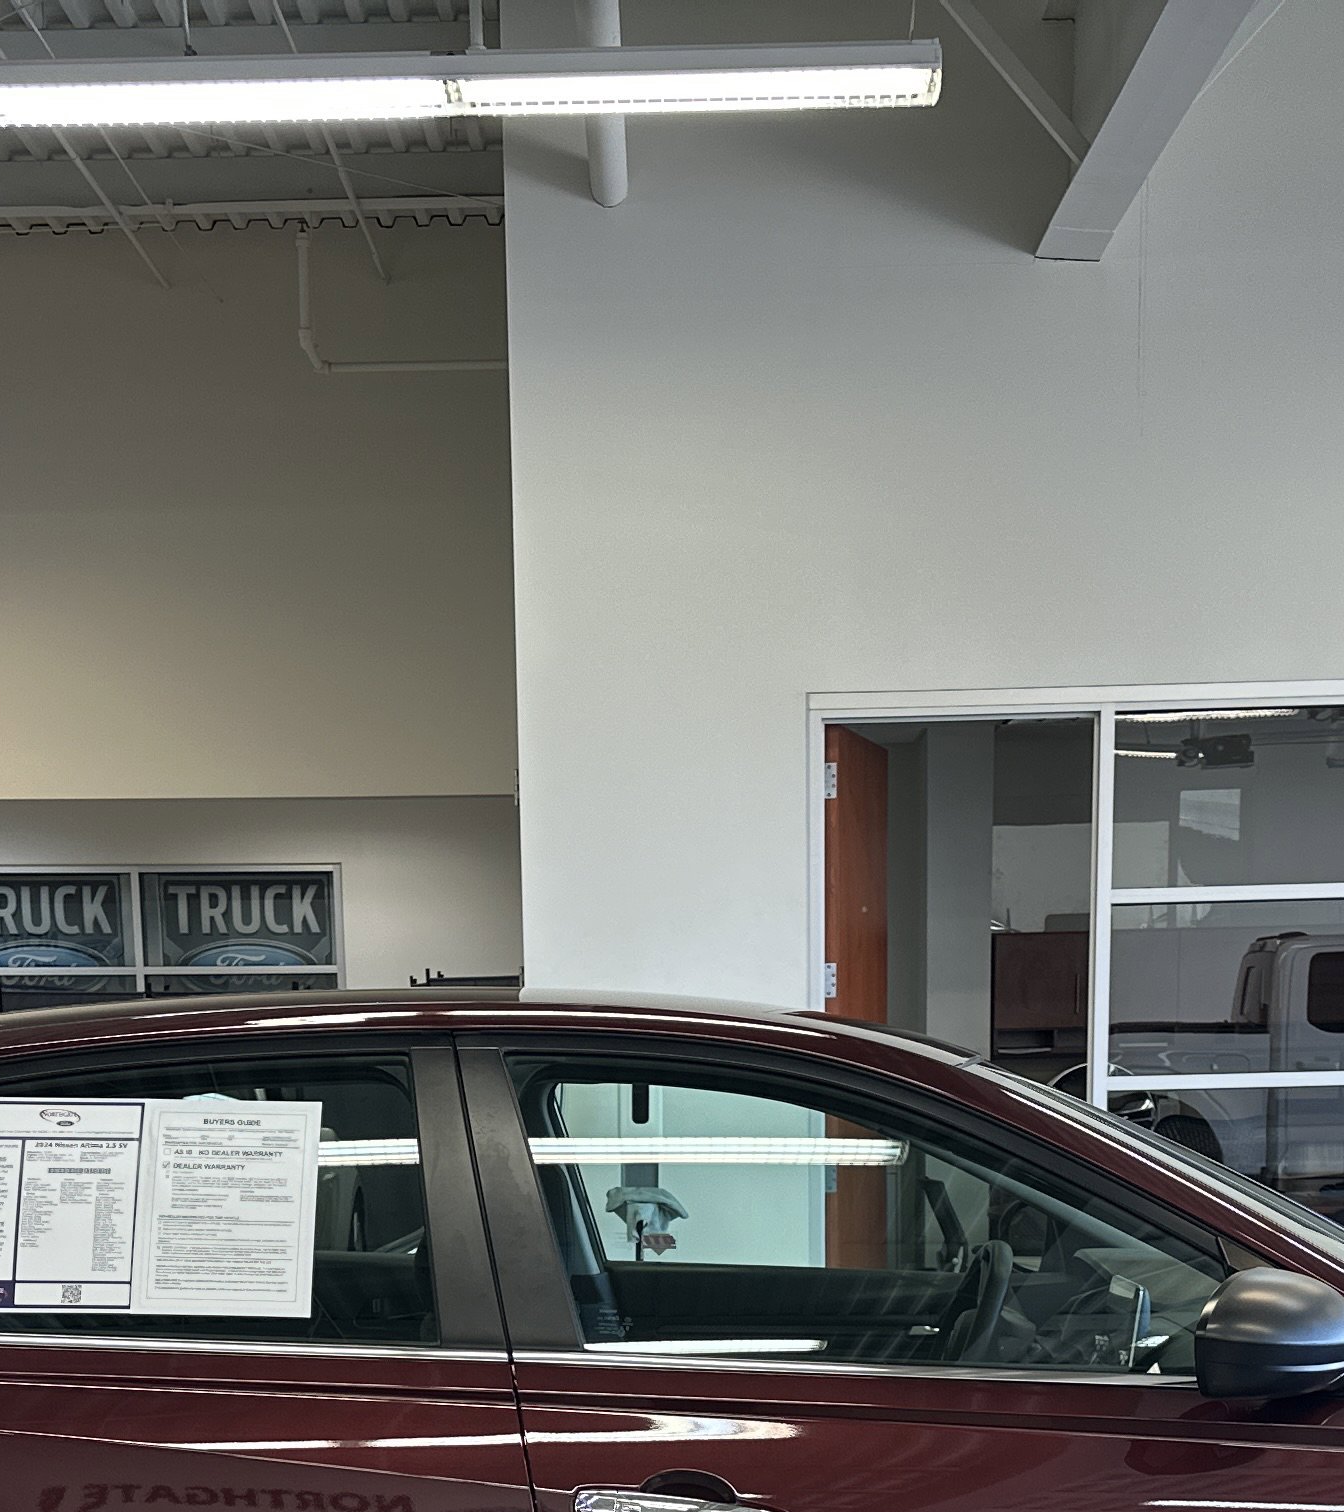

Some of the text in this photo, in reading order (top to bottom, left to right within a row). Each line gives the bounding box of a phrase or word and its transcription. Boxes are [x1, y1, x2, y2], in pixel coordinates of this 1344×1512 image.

[167, 884, 322, 935] TRUCK
[1, 952, 79, 987] Ford
[209, 952, 286, 987] Ford
